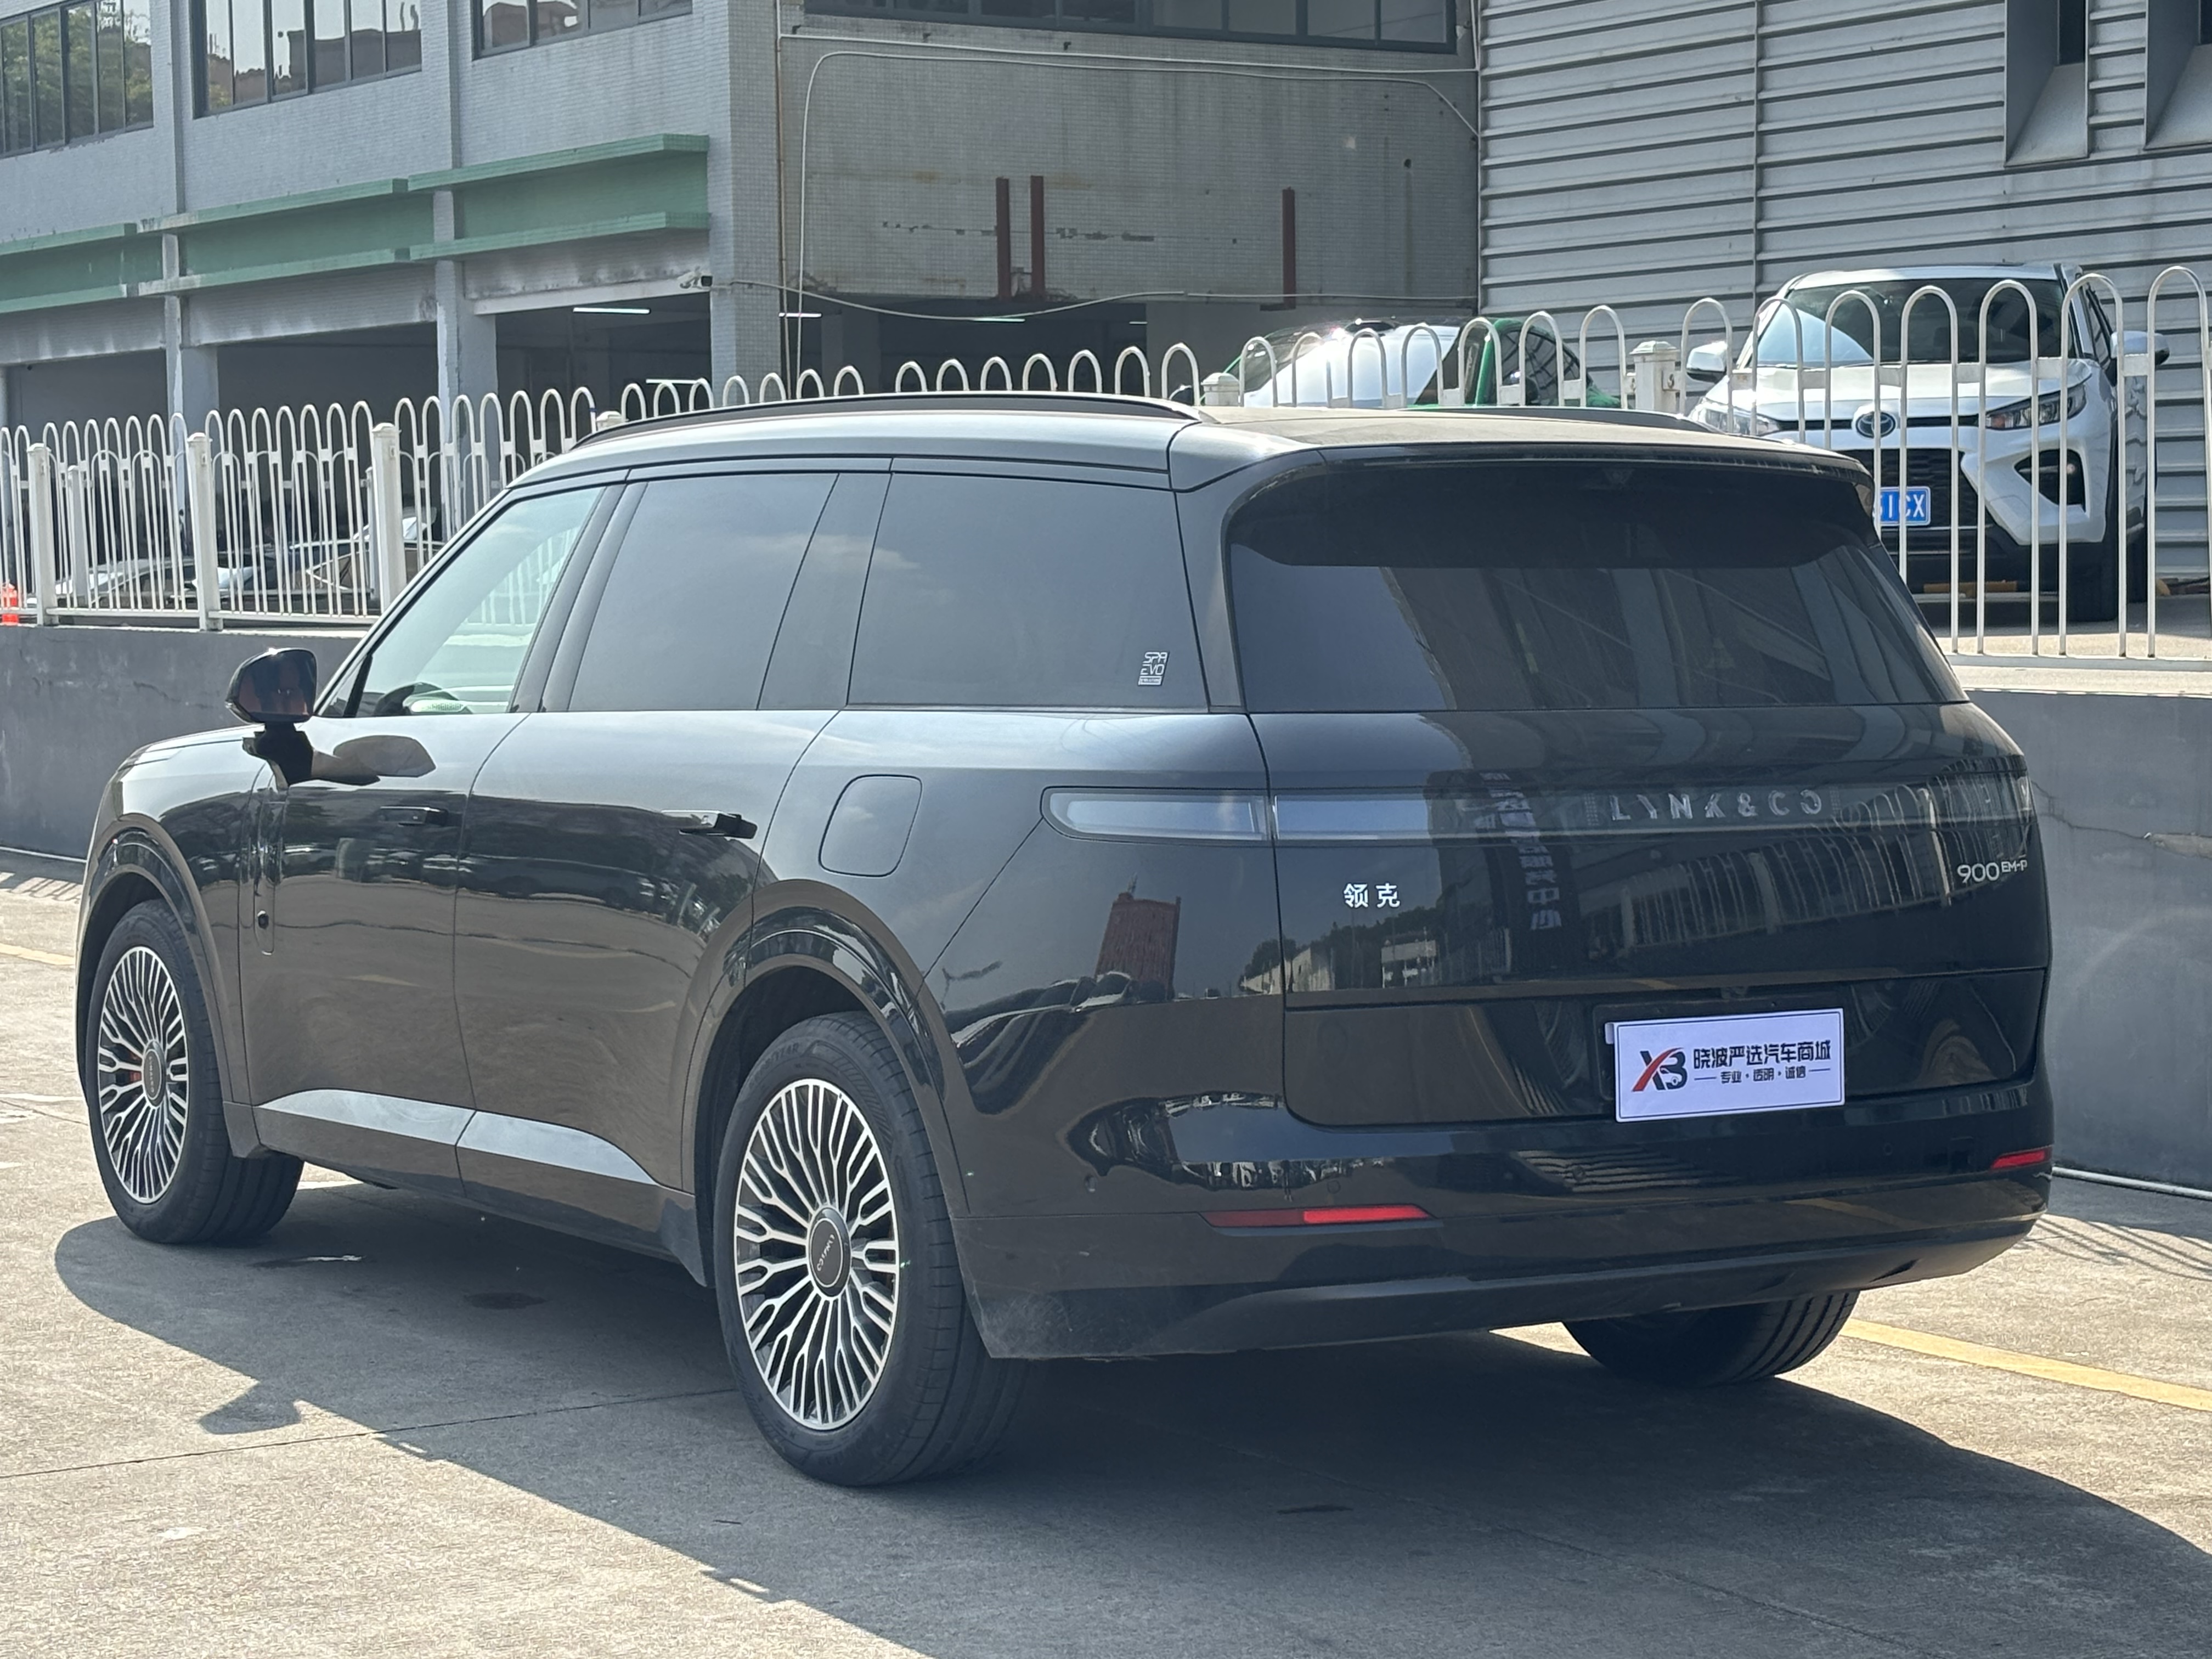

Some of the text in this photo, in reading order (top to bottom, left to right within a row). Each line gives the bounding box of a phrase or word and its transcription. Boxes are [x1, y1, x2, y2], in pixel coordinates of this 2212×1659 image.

[1141, 664, 1165, 675] EVO
[1957, 860, 2028, 884] 900 EM-P
[1344, 883, 1400, 908] 领克
[1694, 1040, 1831, 1069] 晓波严选汽车商城
